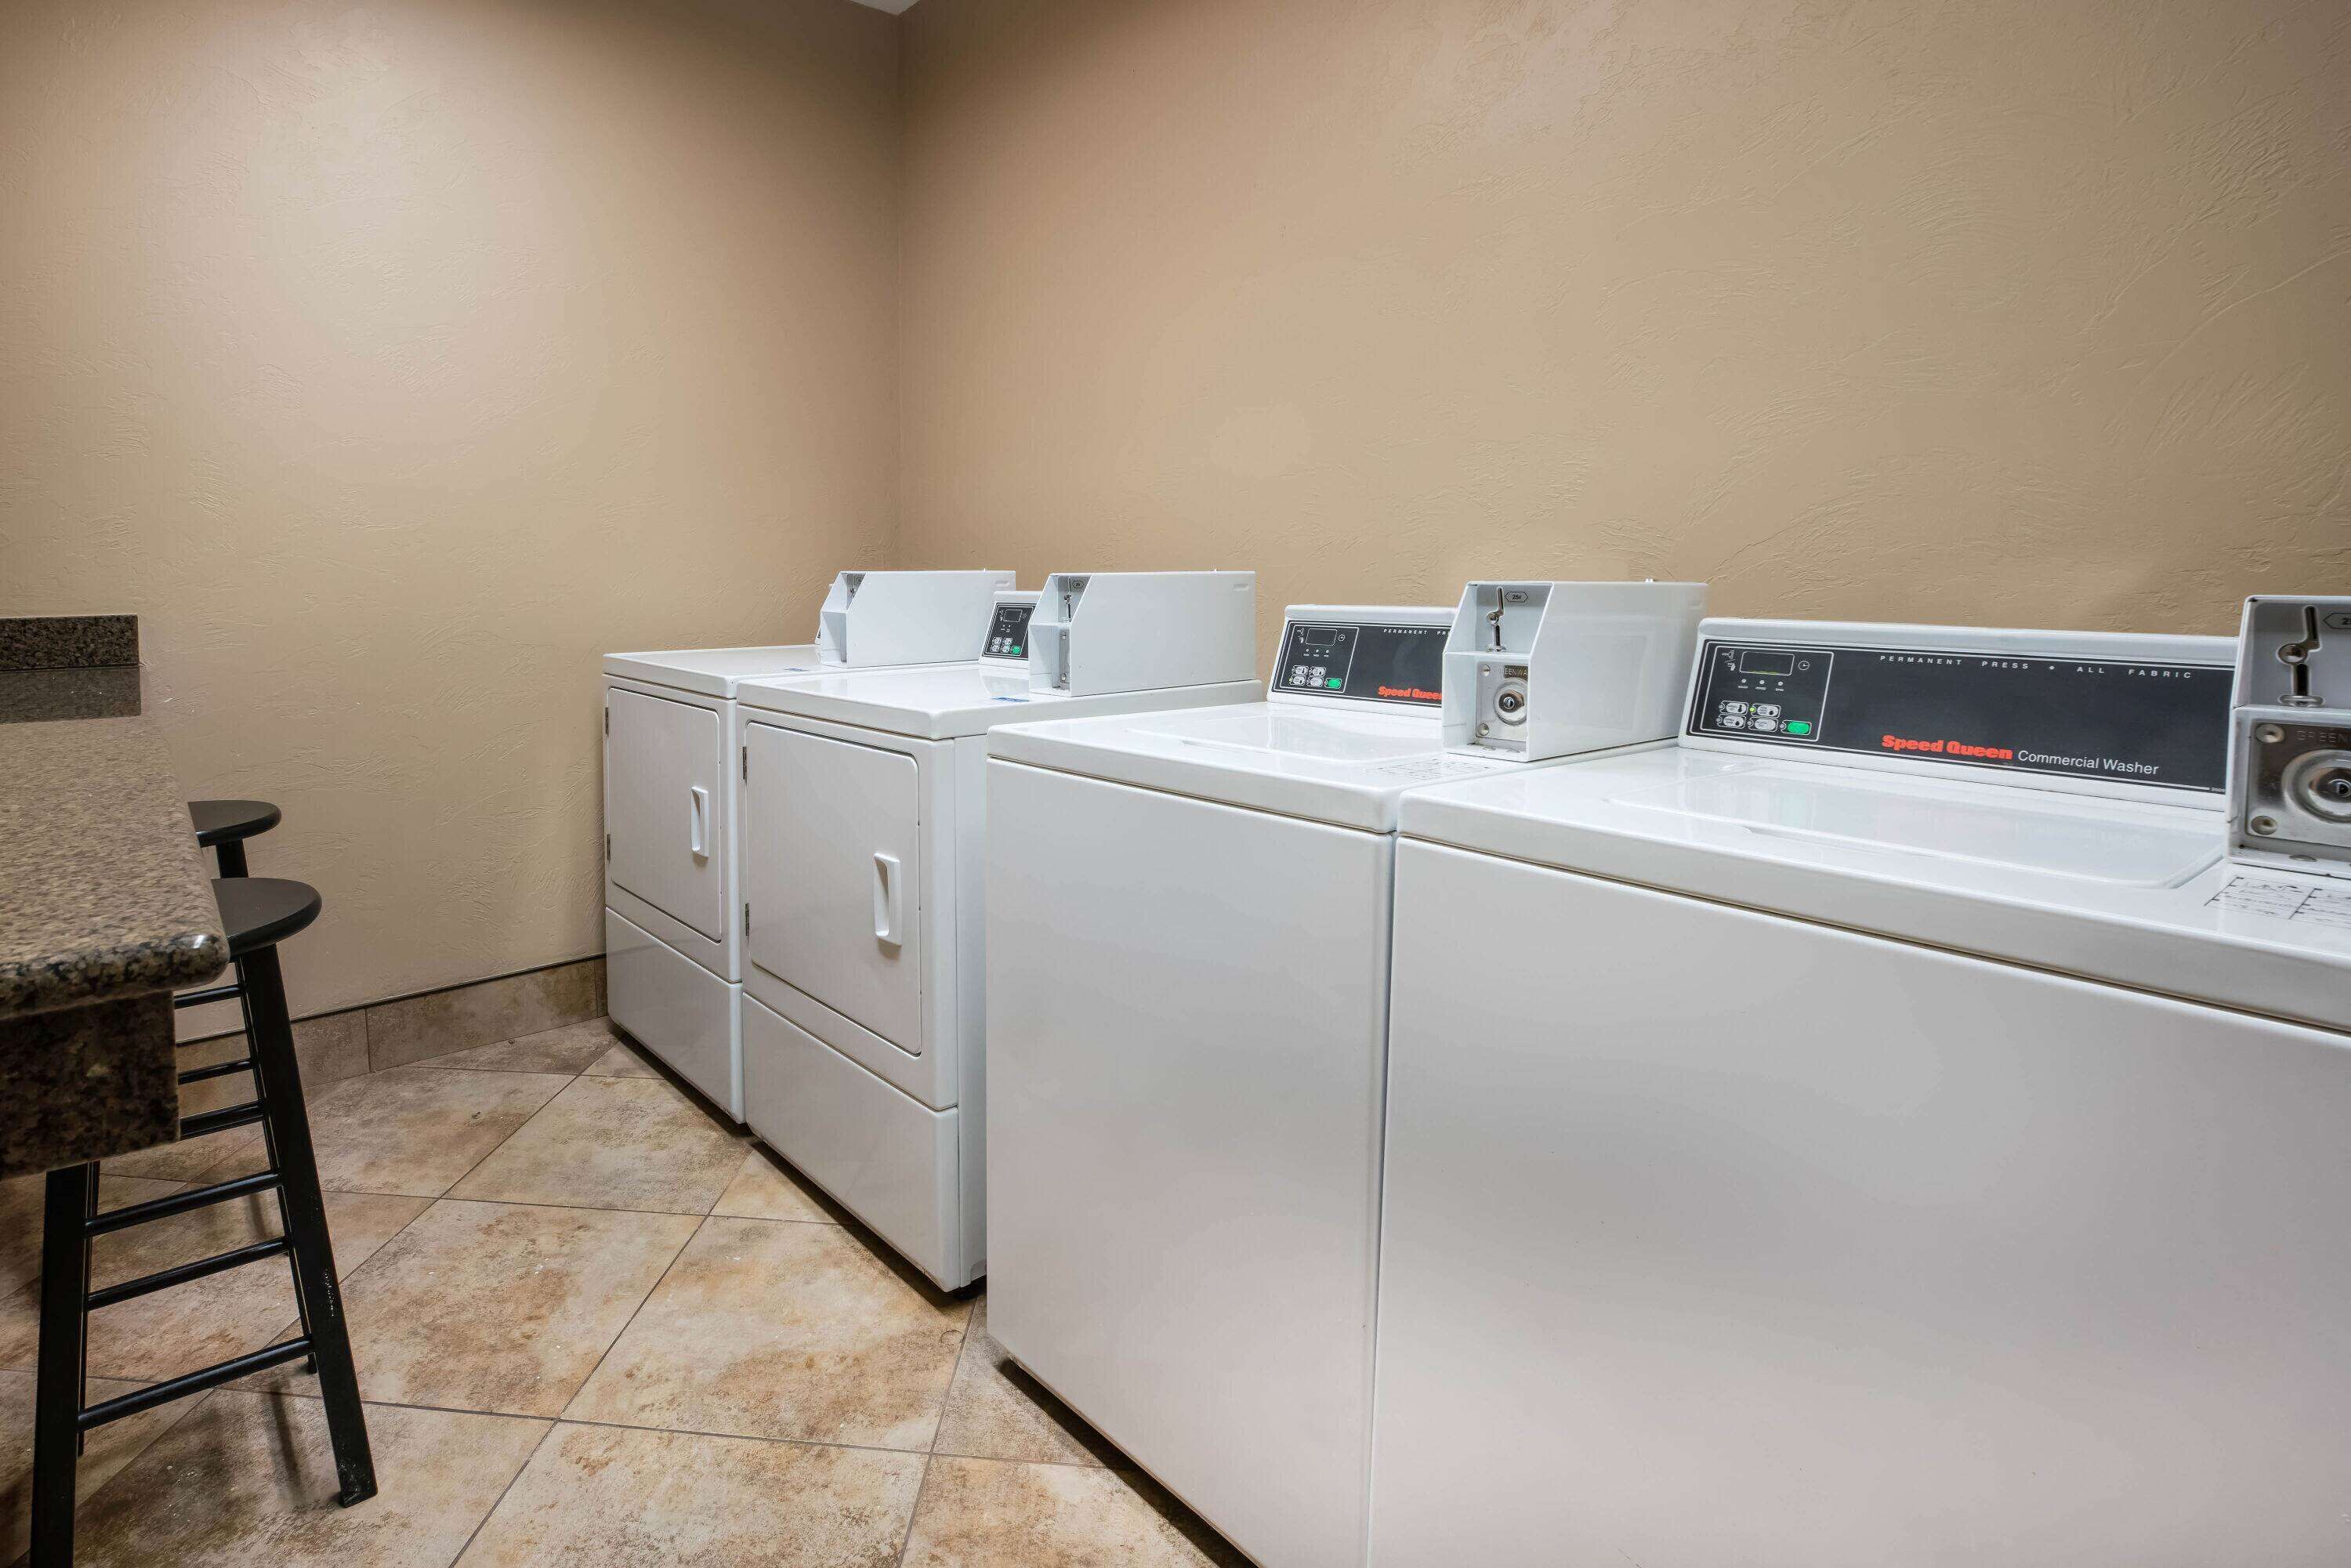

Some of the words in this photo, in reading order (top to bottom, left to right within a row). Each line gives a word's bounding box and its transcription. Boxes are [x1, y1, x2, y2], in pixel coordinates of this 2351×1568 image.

[1880, 655, 1962, 665] PERMANENT
[1981, 661, 2028, 669] PRESS
[2128, 668, 2192, 679] FABRIC
[1378, 686, 1411, 697] Speed
[1882, 734, 1943, 751] Speed
[1946, 741, 2013, 760] Queen
[2018, 750, 2099, 770] Commercial
[2103, 759, 2159, 774] Washer
